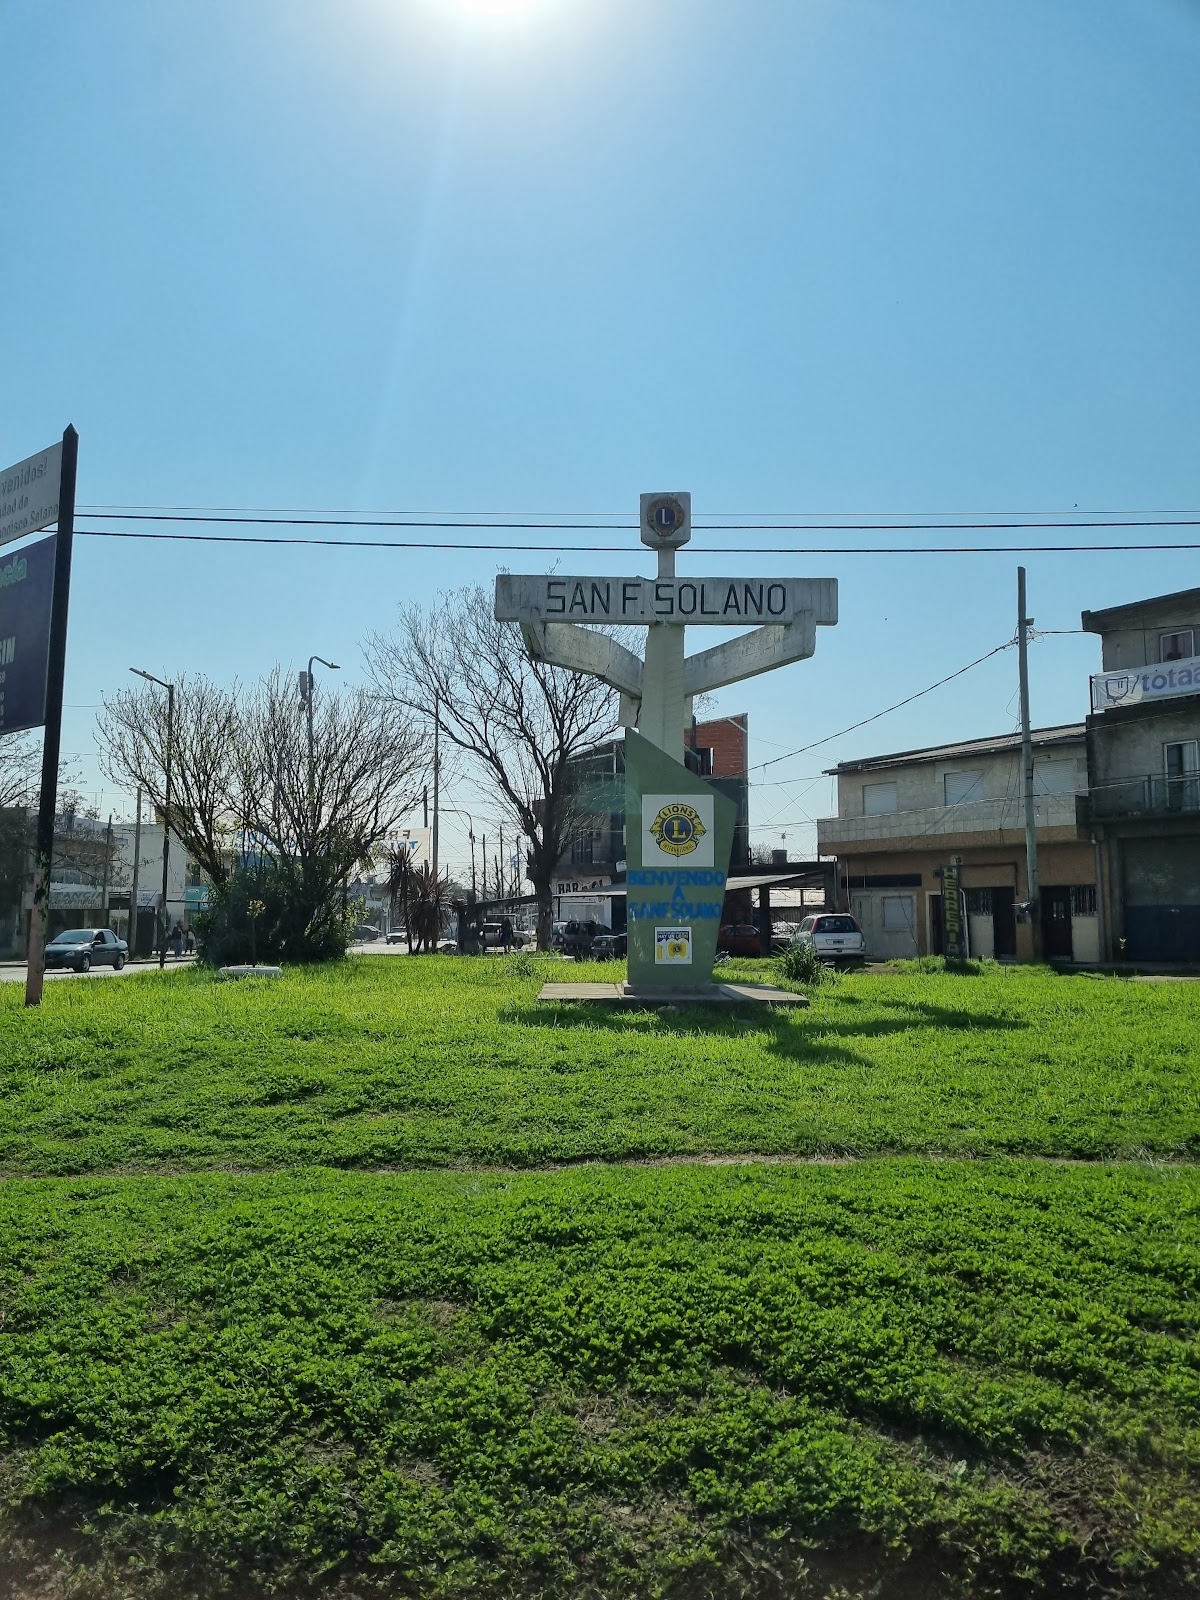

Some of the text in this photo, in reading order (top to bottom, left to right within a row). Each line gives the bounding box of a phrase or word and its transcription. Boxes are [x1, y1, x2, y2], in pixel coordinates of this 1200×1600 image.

[546, 581, 787, 615] SAN F. SOLANO
[662, 805, 695, 817] LIONS
[671, 819, 687, 839] L
